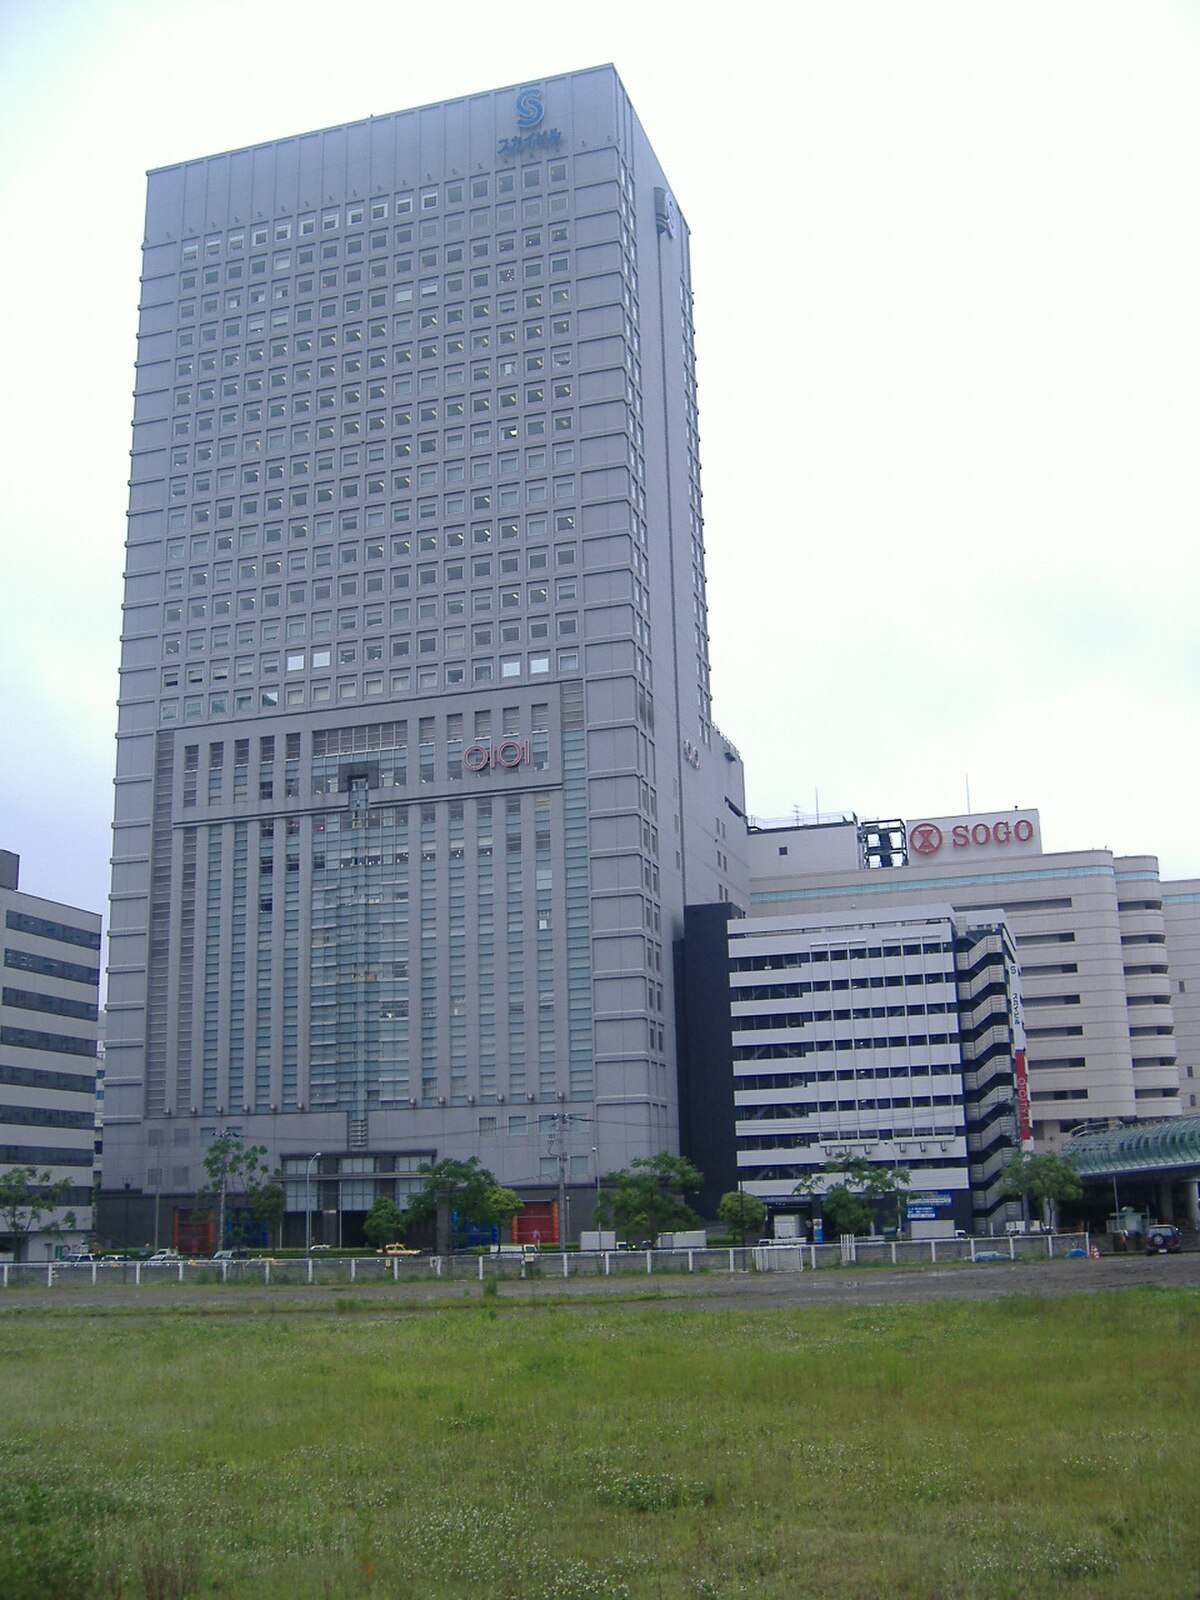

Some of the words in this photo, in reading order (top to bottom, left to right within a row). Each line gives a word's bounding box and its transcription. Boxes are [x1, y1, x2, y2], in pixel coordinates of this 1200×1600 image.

[515, 88, 544, 128] S
[497, 128, 562, 153] スカイビル
[952, 819, 1034, 849] SOGO
